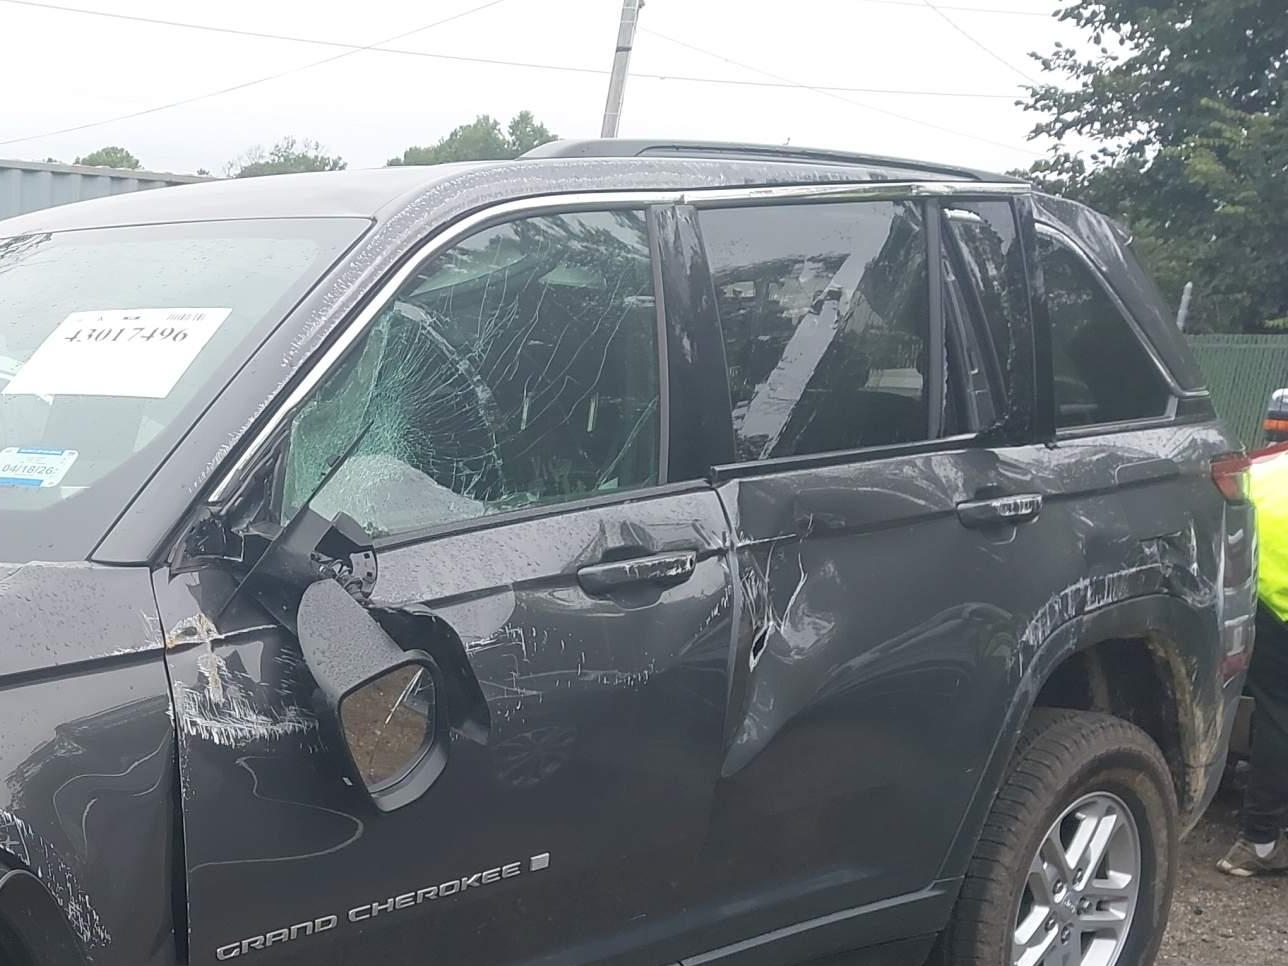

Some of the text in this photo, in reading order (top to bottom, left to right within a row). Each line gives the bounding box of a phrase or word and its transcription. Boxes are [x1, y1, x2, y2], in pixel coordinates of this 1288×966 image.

[64, 327, 189, 343] 43017496
[216, 862, 522, 961] GRAND CHEROKEE
